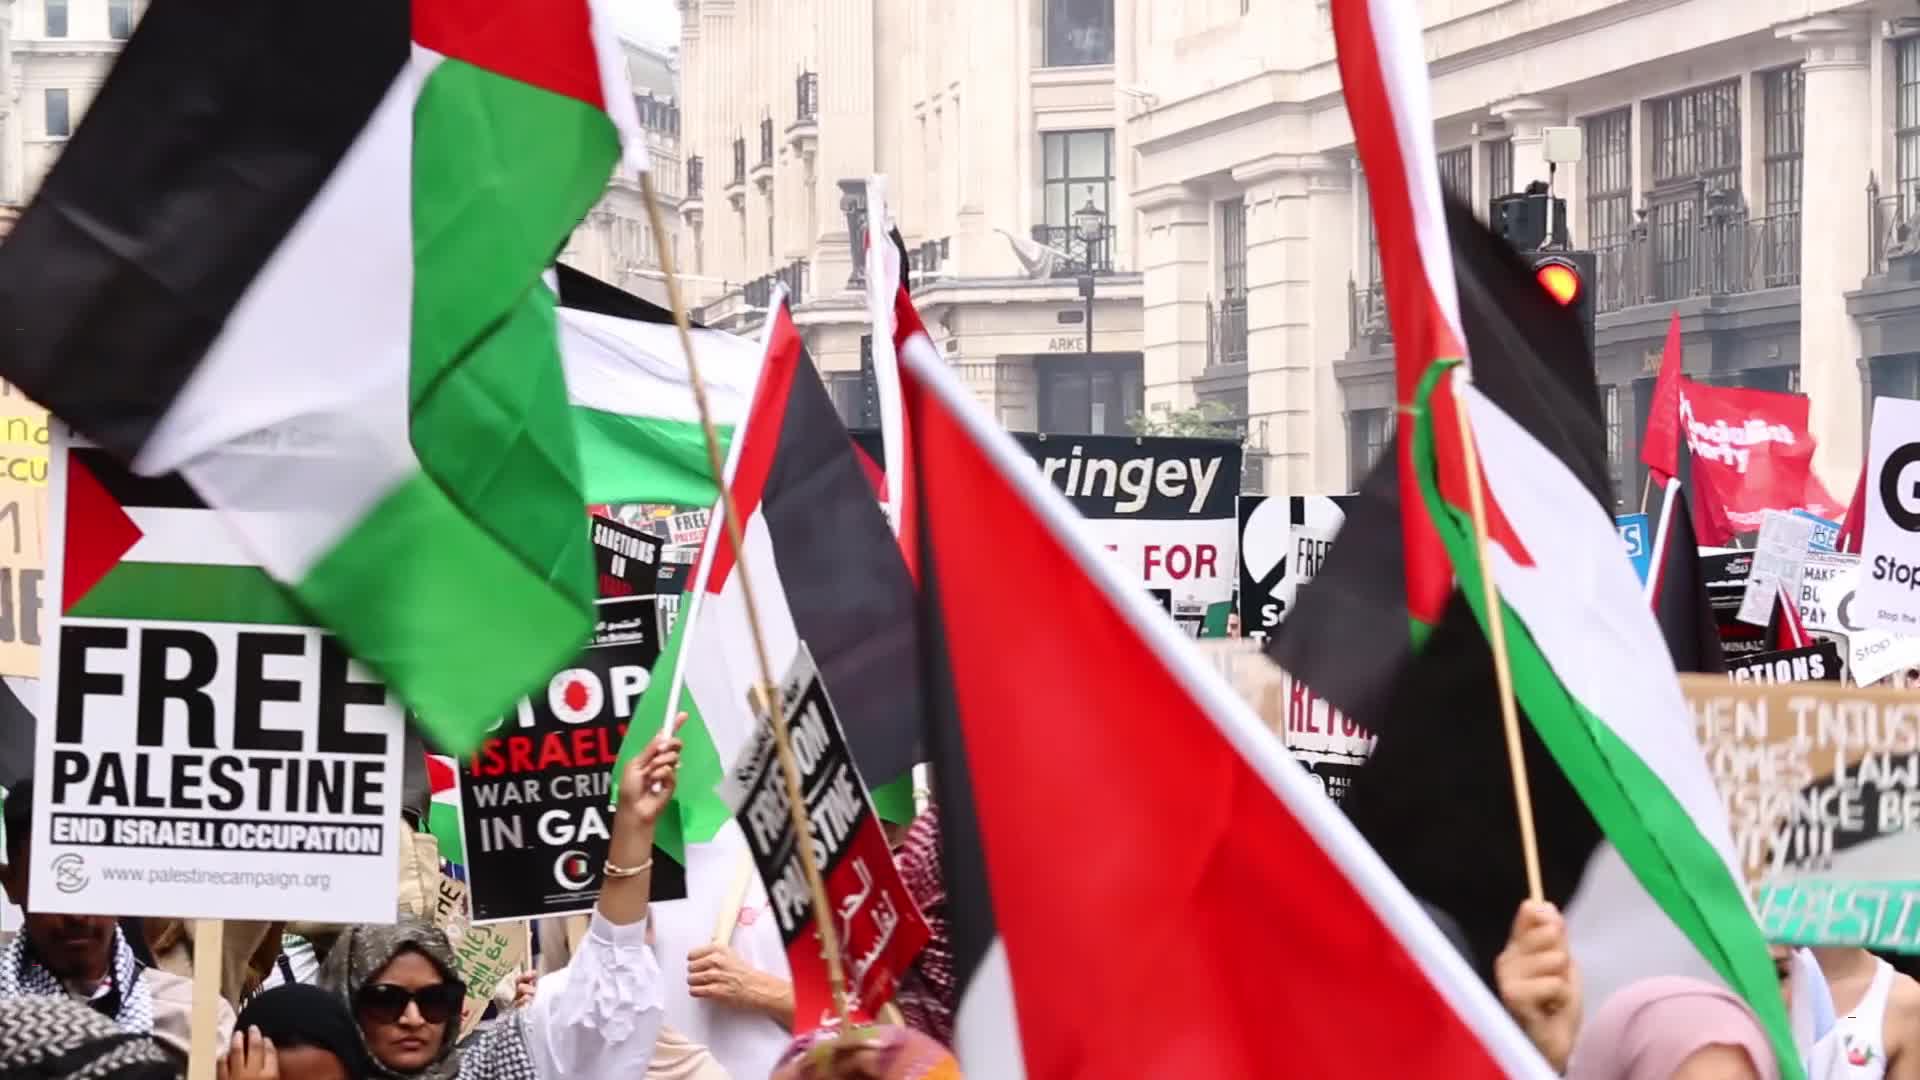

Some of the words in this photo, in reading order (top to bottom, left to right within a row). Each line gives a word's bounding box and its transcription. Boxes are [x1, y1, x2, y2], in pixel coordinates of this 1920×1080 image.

[1048, 337, 1087, 351] ARKE
[1143, 544, 1217, 581] FOR
[1296, 537, 1334, 578] FRE
[55, 625, 388, 755] FREE
[51, 749, 386, 816] PALESTINE
[474, 778, 542, 809] WAR
[53, 818, 106, 844] END
[113, 821, 214, 849] ISRAELI
[222, 825, 381, 854] OCCUPATION
[480, 815, 524, 852] IN
[537, 805, 615, 847] GA
[102, 865, 331, 892] www.palestinecampaign.org
